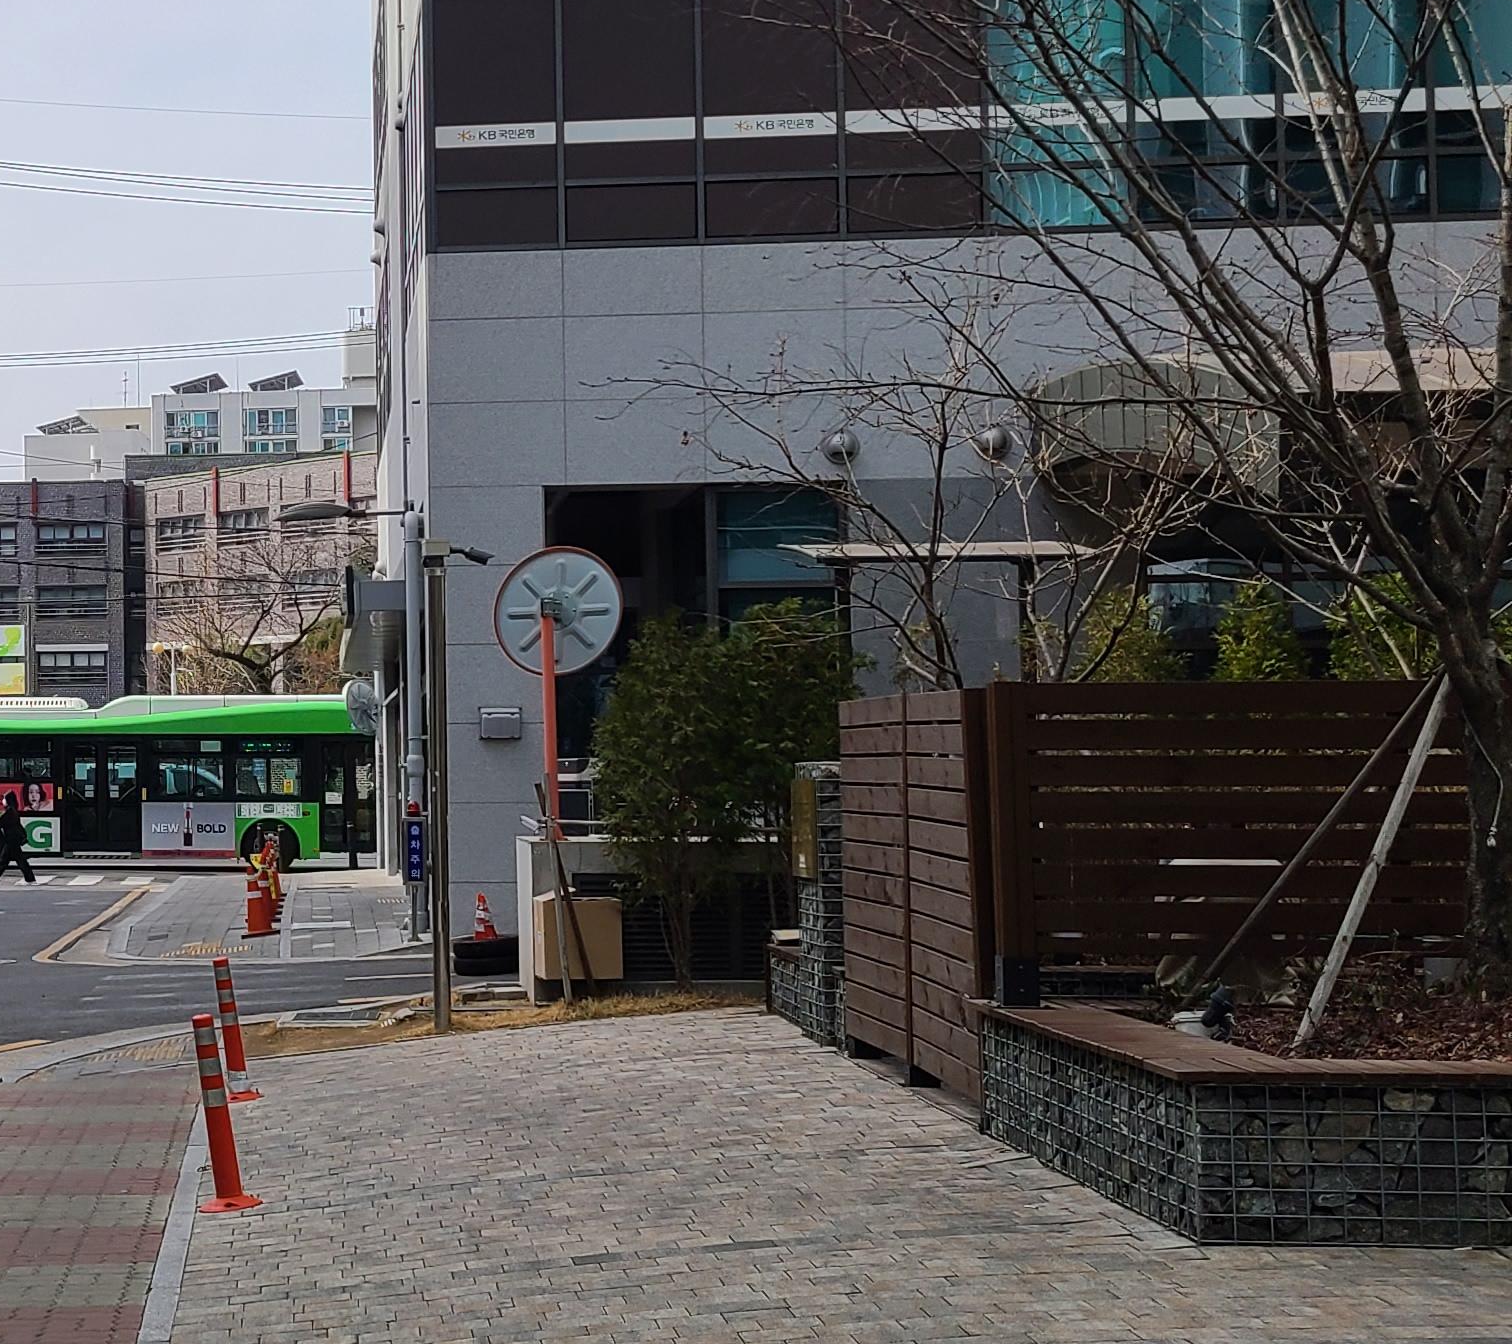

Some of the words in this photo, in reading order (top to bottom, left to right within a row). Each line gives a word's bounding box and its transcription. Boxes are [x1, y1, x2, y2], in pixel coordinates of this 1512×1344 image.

[756, 120, 775, 130] KB
[777, 118, 815, 130] 국민은행
[478, 130, 497, 140] KB
[498, 128, 536, 140] 국민은행
[151, 822, 180, 834] NEW
[196, 823, 227, 834] BOLD
